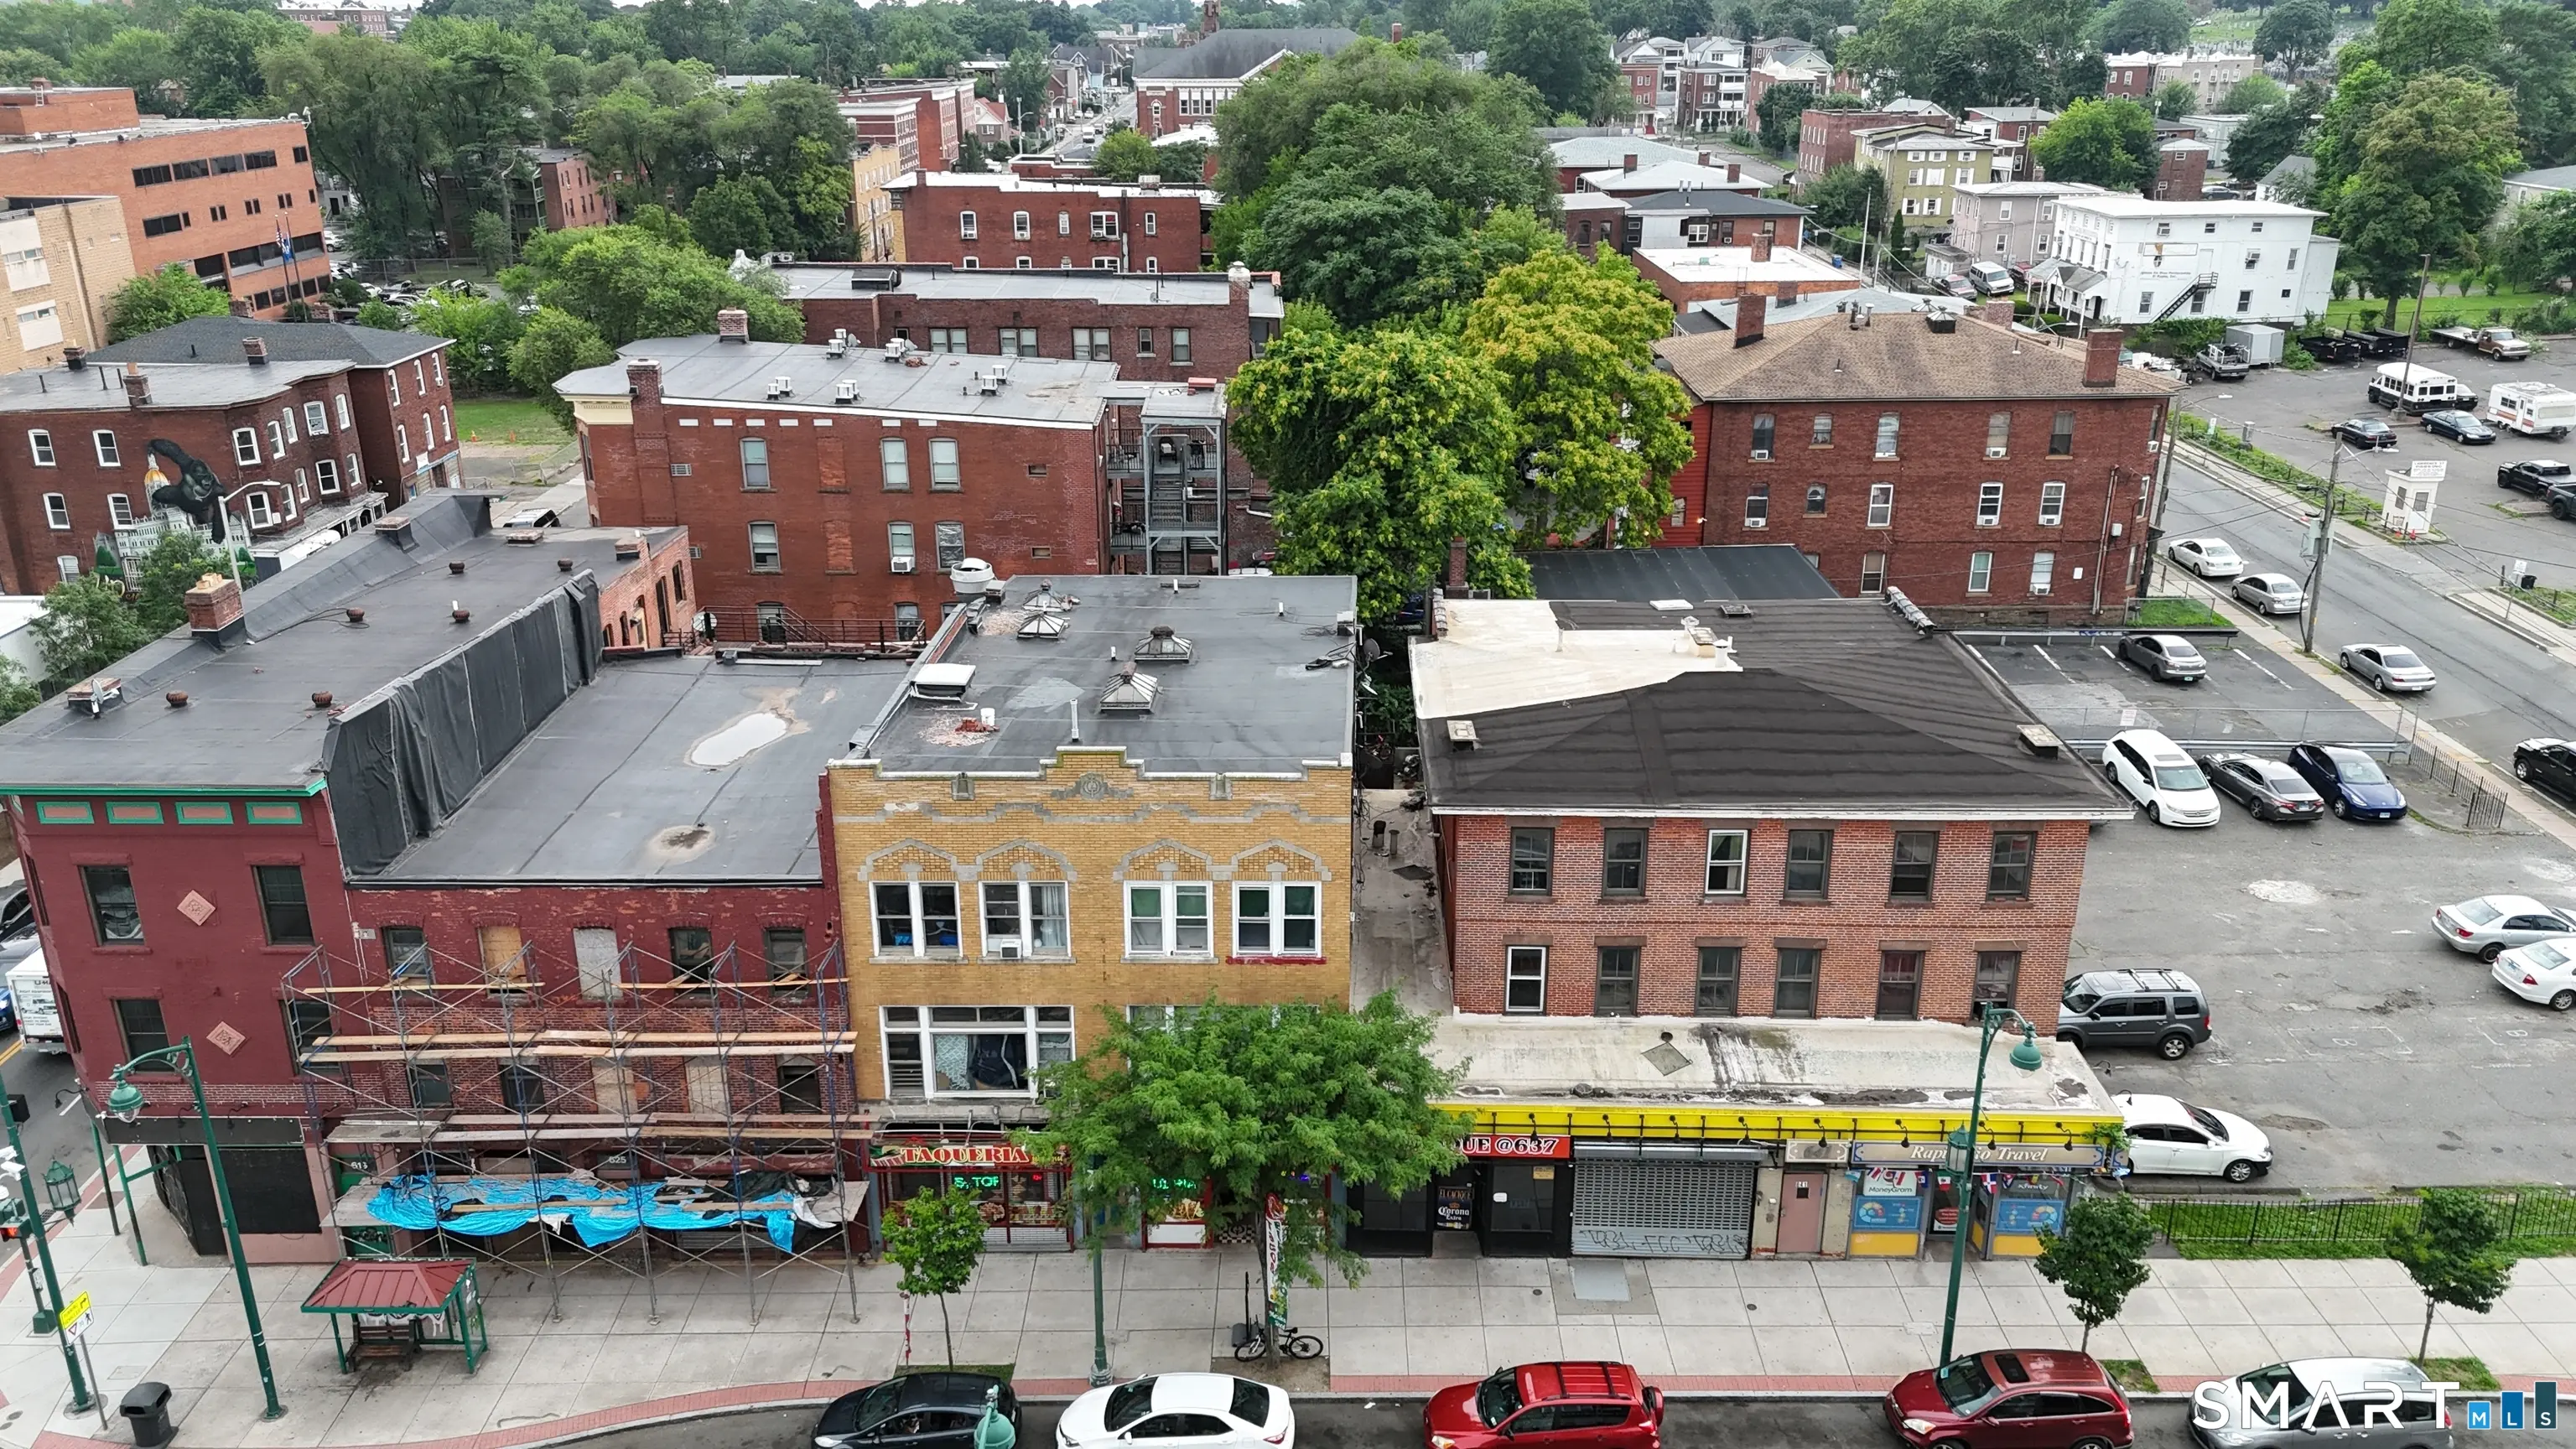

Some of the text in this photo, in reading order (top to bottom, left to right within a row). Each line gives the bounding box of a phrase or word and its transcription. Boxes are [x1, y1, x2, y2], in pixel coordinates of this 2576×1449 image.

[1494, 1137, 1559, 1156] @637
[1997, 1146, 2048, 1161] Travel
[901, 1146, 1030, 1164] TAQUERIA
[1437, 1206, 1470, 1217] Corona
